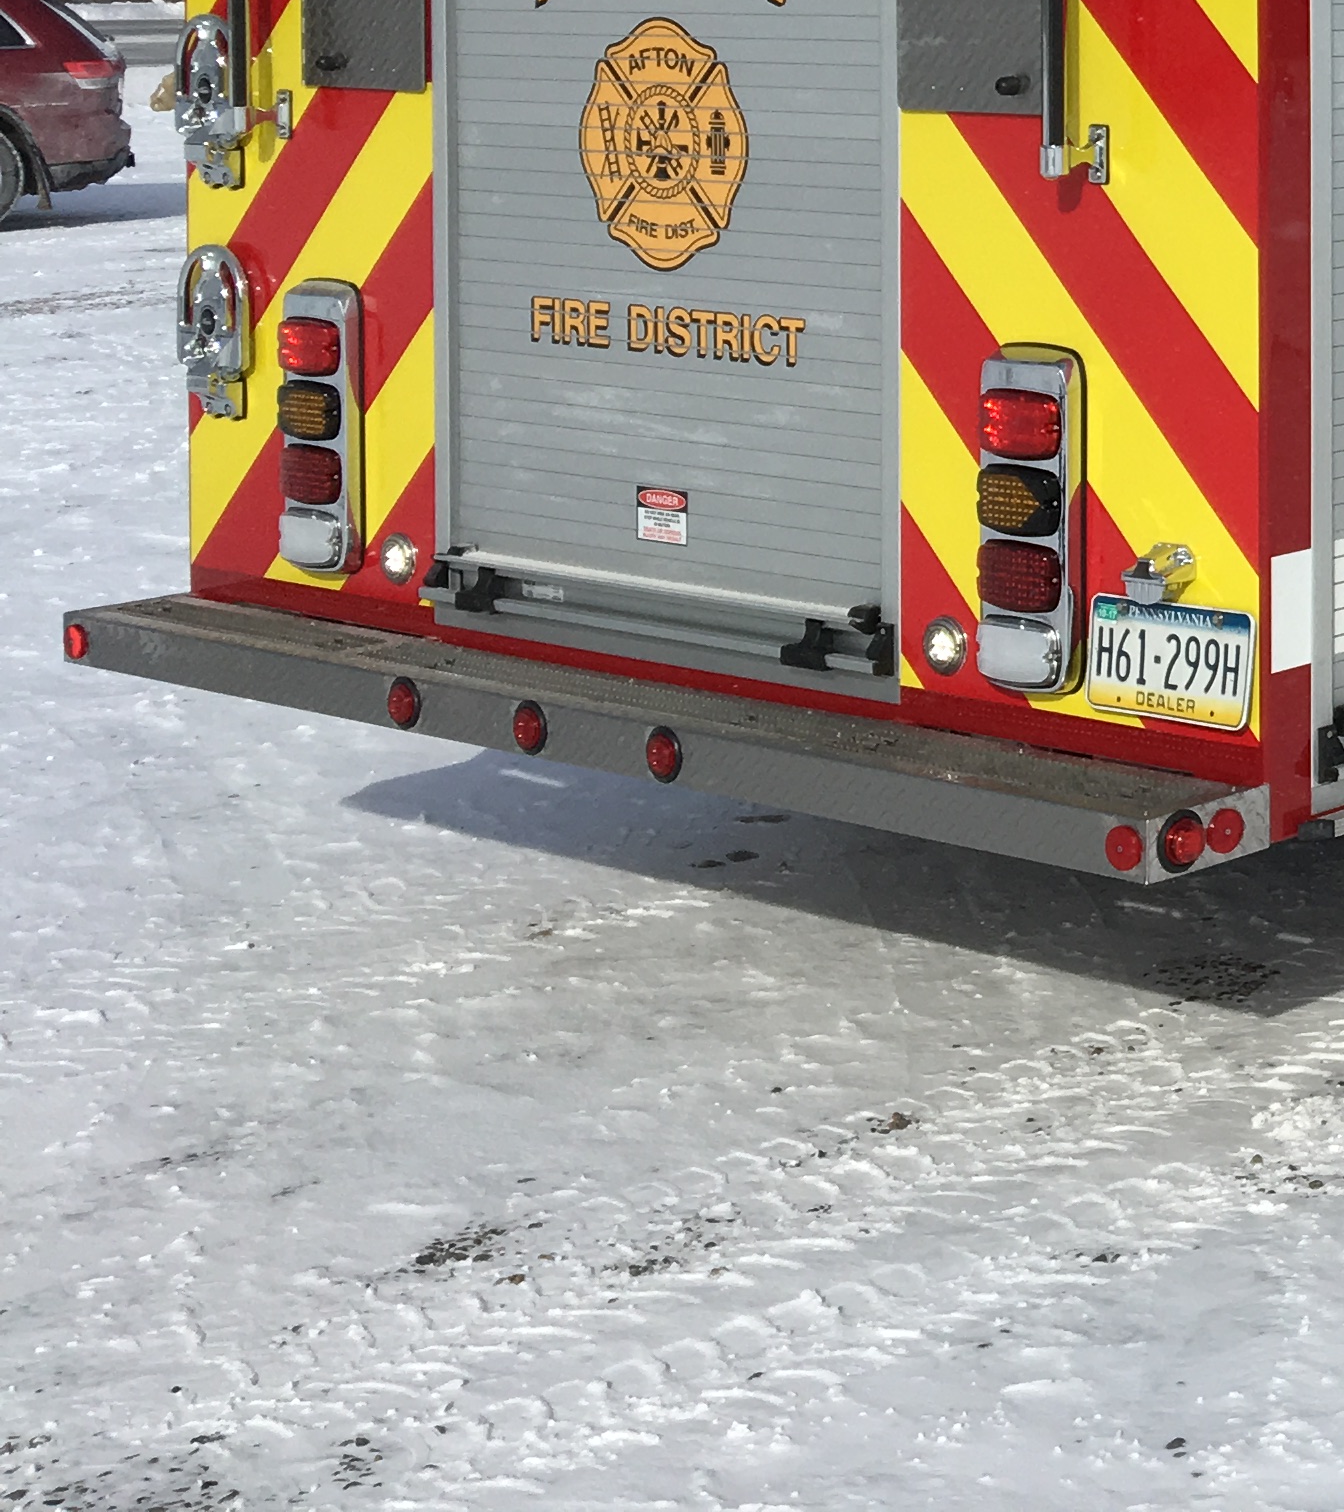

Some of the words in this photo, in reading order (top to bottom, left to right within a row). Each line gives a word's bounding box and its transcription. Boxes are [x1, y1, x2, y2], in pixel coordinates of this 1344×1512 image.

[628, 47, 695, 77] AFTON
[627, 213, 658, 238] FIRE
[664, 218, 699, 240] DIST.
[531, 296, 610, 348] FIRE
[627, 304, 805, 367] DISTRICT
[646, 493, 679, 506] DANGER
[1129, 605, 1213, 628] PENNSYLVANIA
[1136, 691, 1195, 713] DEALER
